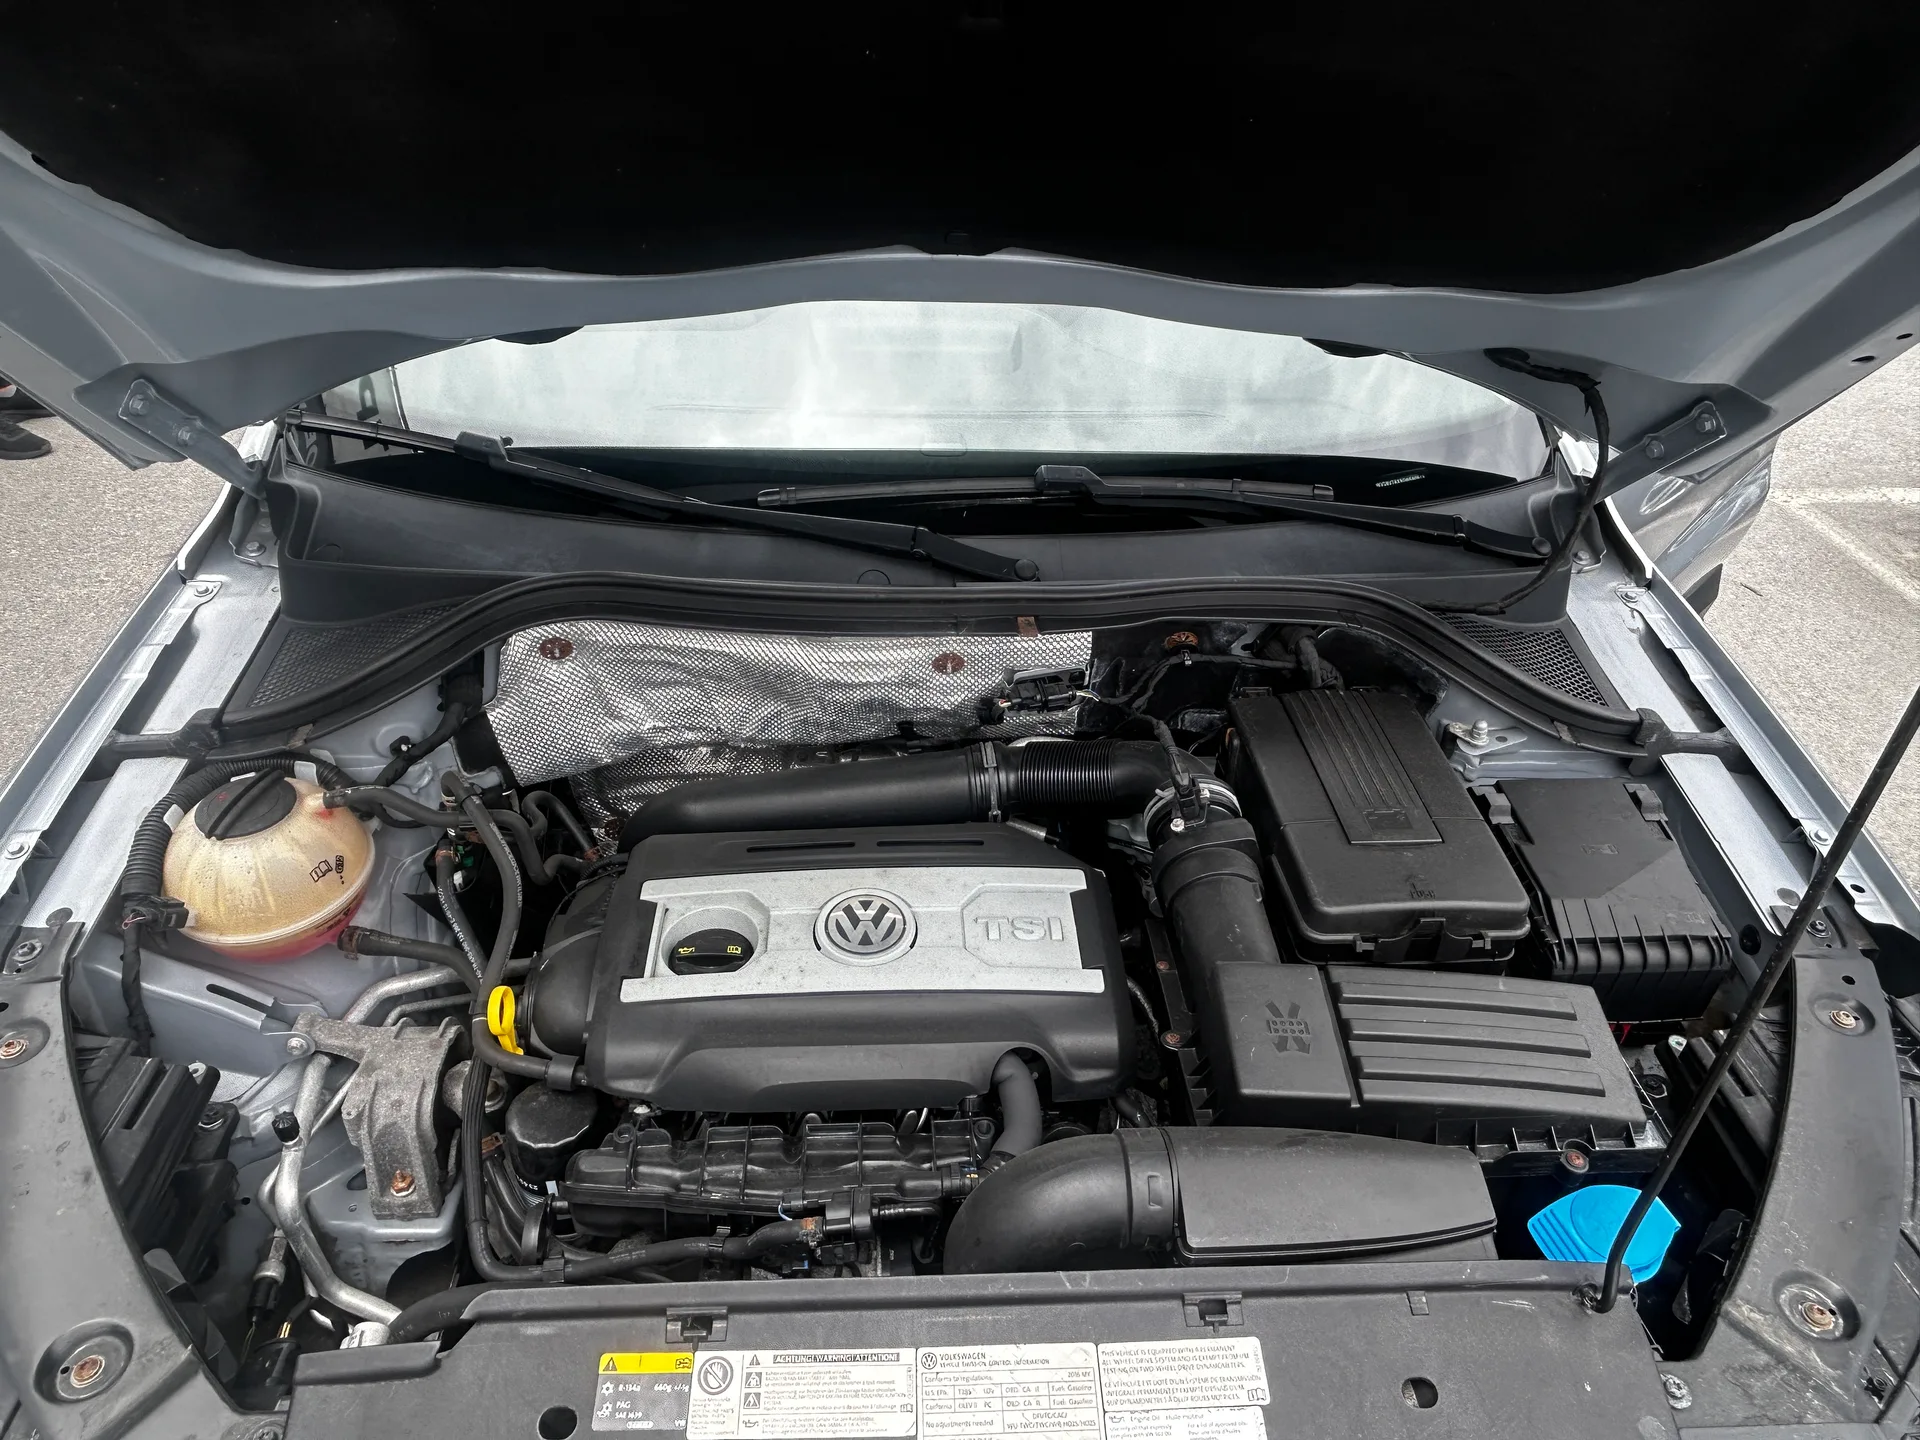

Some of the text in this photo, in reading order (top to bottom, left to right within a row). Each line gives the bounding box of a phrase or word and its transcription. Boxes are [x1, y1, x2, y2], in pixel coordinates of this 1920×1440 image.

[825, 896, 906, 954] VW
[975, 916, 1064, 942] TSI
[940, 1352, 986, 1360] VOLKSWAGEN
[616, 1401, 631, 1409] PAG
